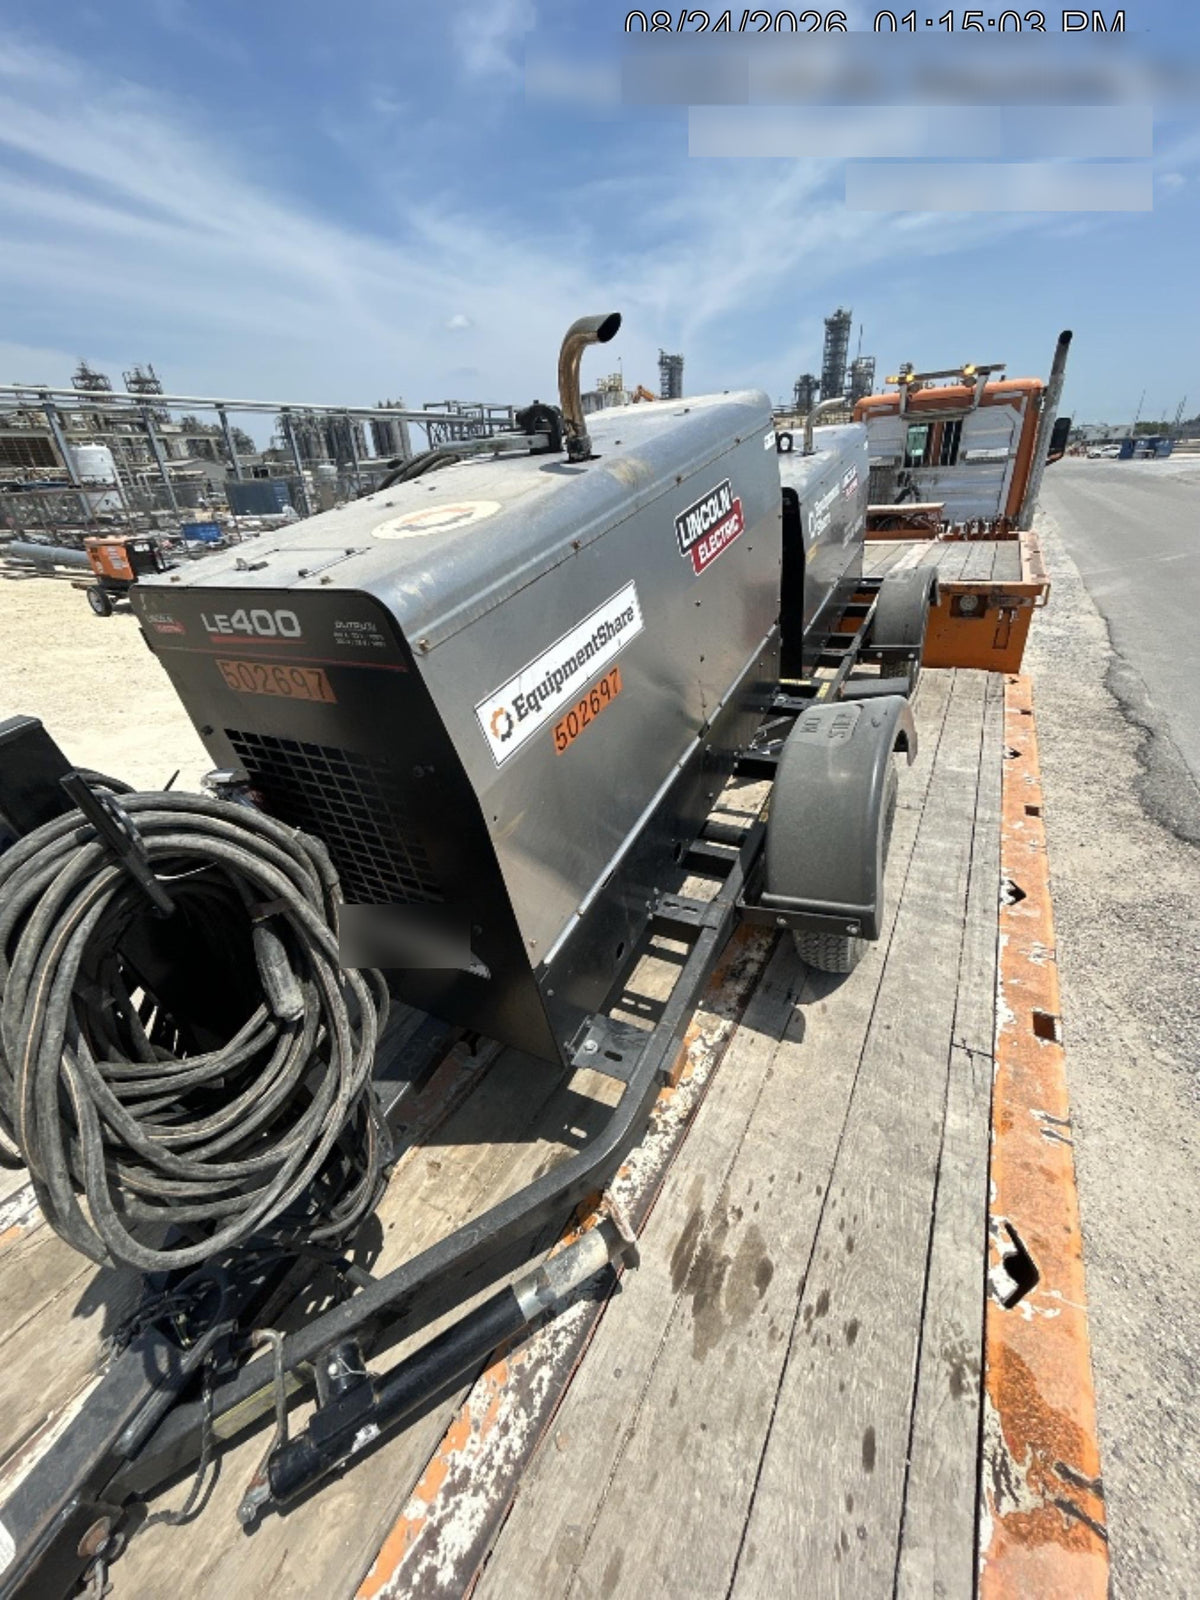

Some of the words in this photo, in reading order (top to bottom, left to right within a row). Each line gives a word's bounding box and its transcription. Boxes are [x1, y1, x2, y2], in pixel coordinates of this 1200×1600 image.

[679, 485, 732, 548] LINCOLN
[698, 514, 740, 564] ELECTRIC
[201, 609, 303, 637] LE400
[220, 661, 326, 699] 502697
[511, 605, 635, 722] EquipmentShare
[554, 667, 619, 751] 502697
